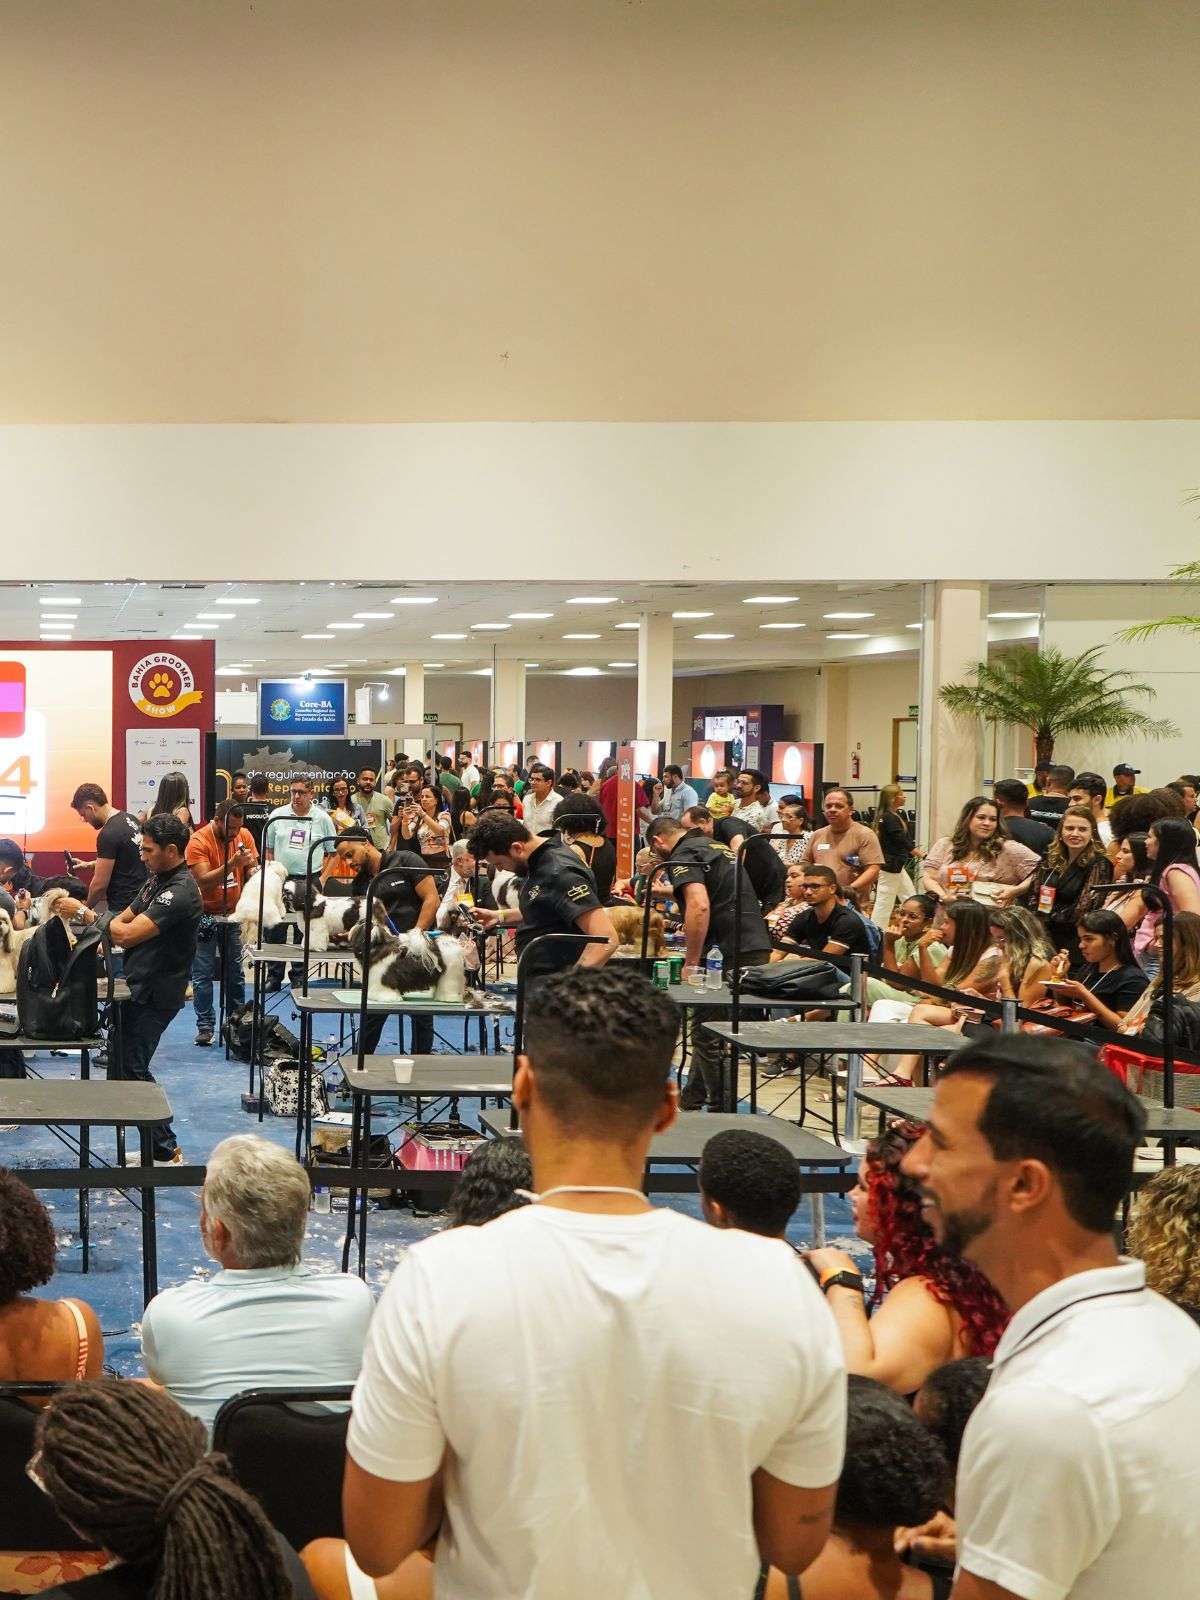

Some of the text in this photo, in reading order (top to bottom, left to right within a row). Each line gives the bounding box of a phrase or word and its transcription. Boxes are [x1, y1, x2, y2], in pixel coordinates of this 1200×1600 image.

[132, 656, 191, 688] BAHIA GROOMER
[300, 700, 332, 709] Core-BA
[144, 705, 176, 715] SHOW
